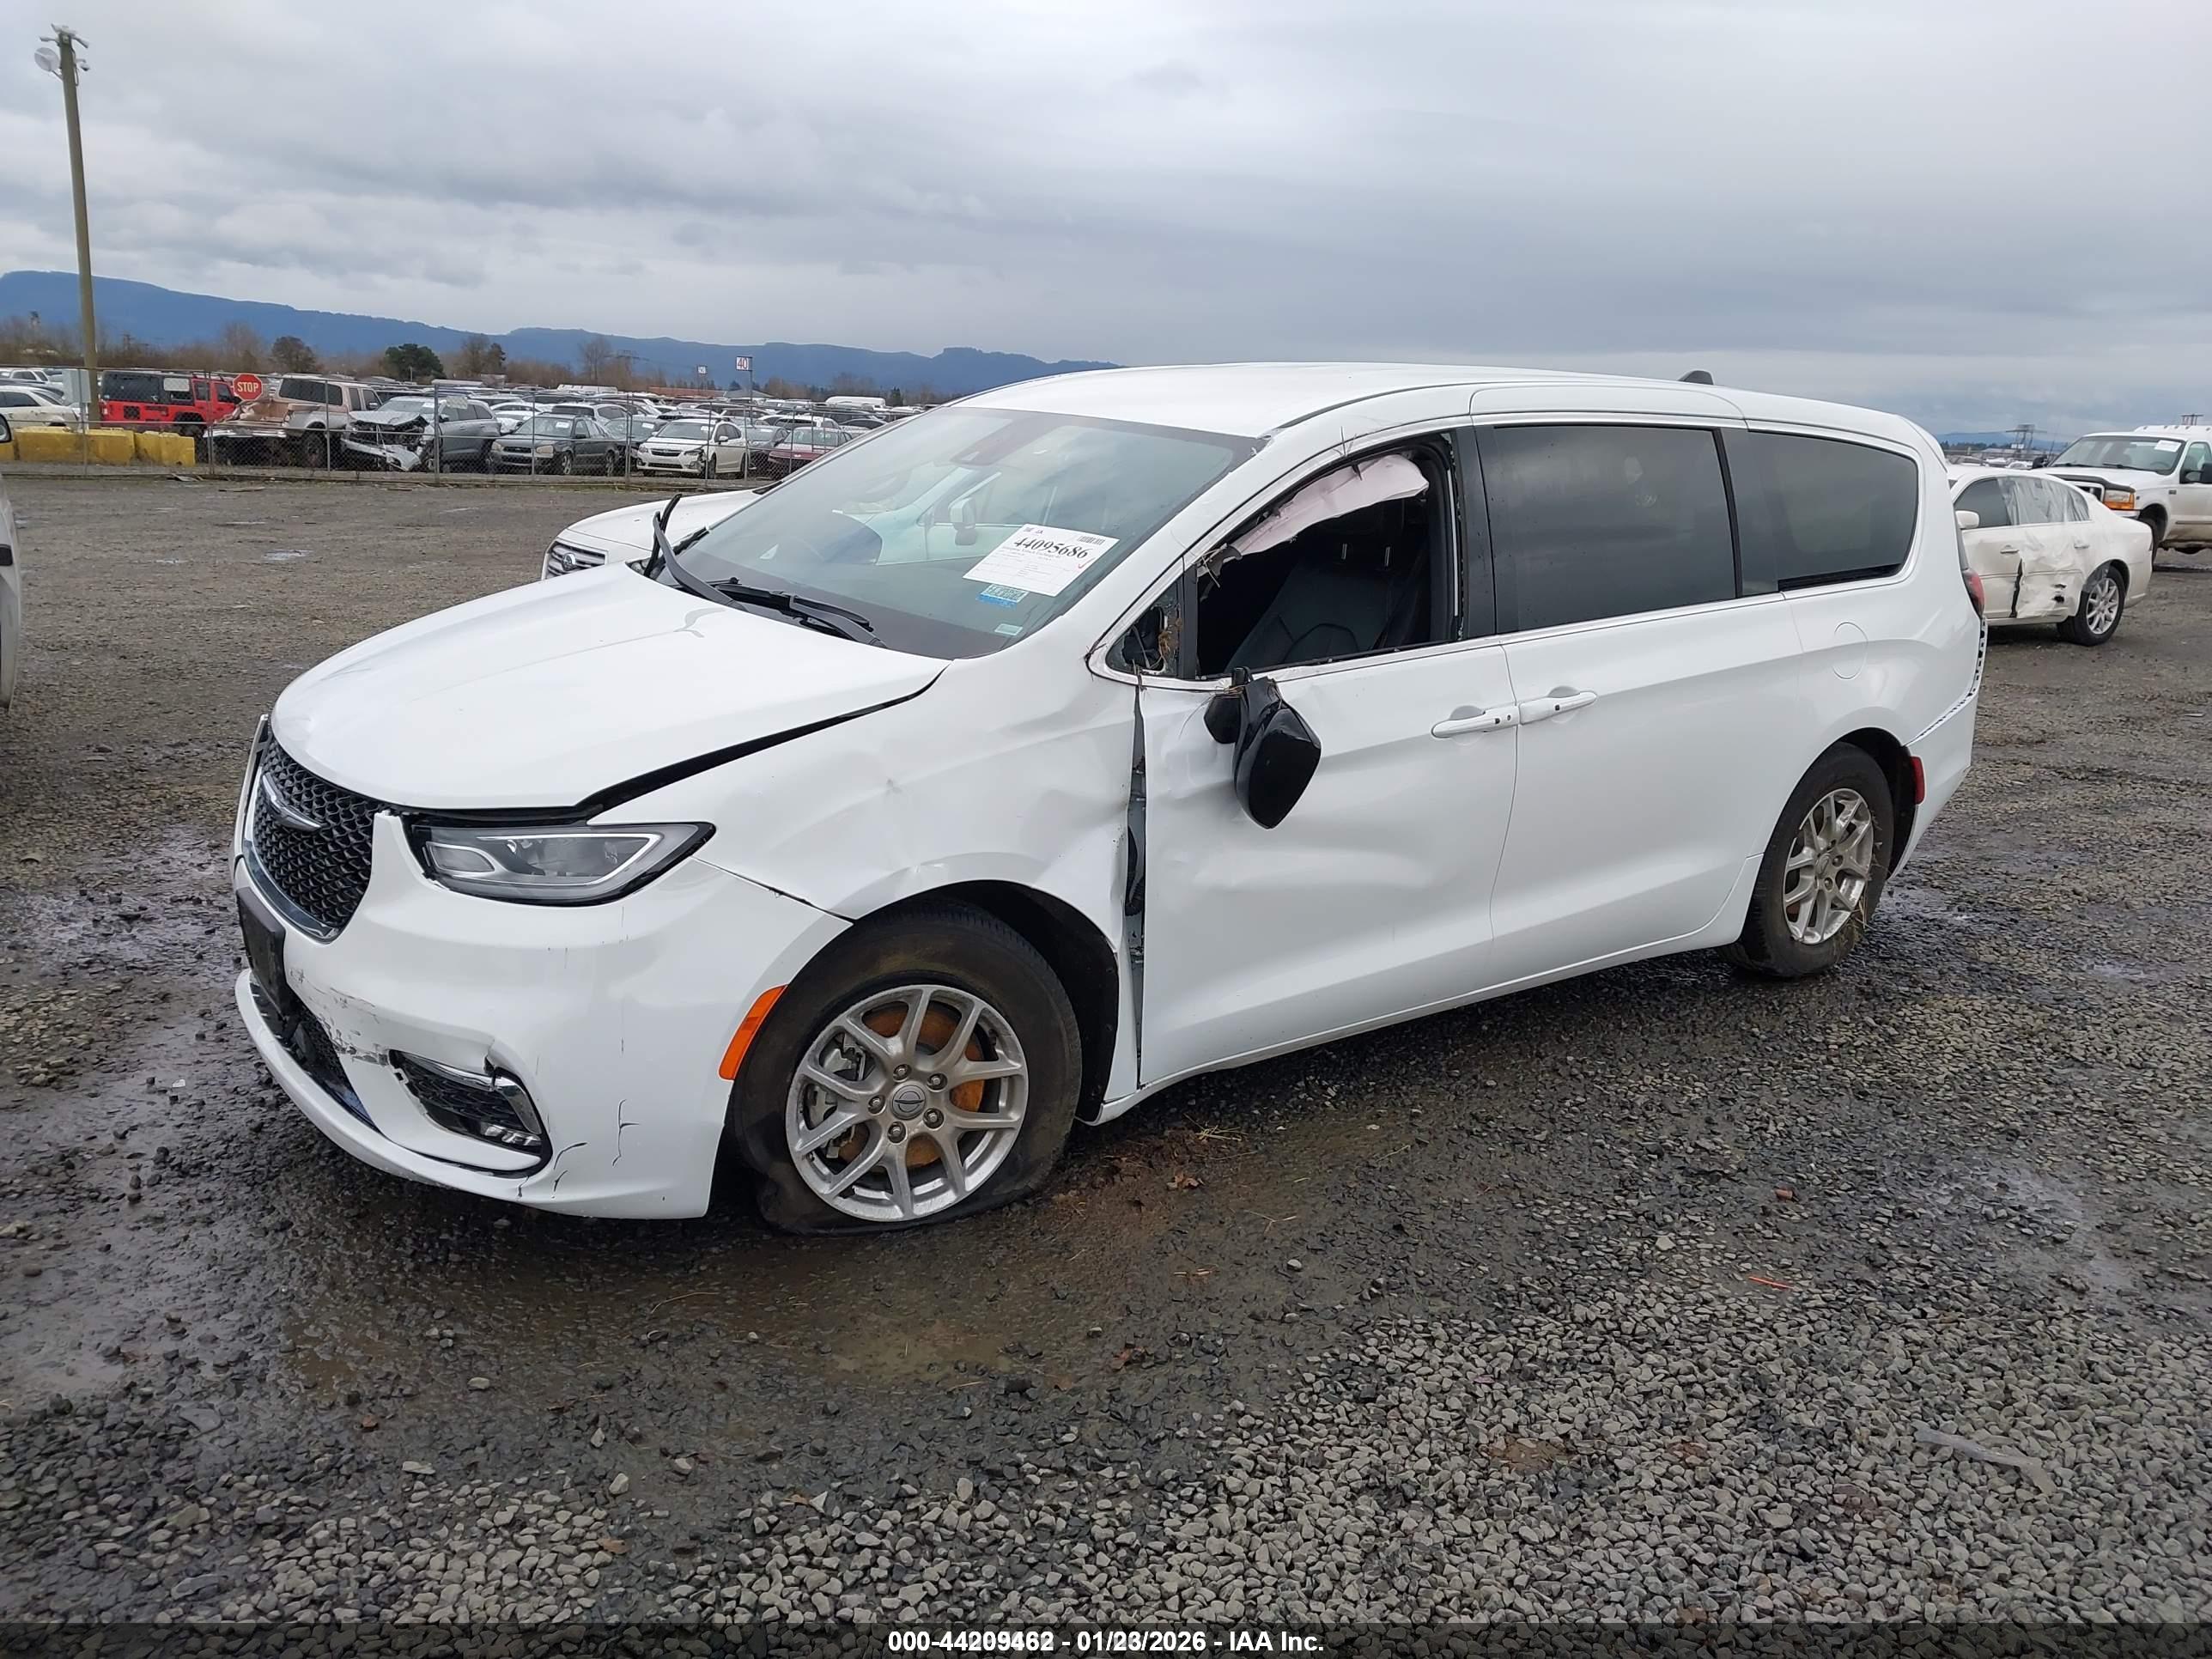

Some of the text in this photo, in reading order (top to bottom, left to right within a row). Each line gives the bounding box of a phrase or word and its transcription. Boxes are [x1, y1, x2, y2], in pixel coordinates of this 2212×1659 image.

[737, 357, 748, 369] 40
[237, 381, 259, 392] STOP
[1013, 537, 1093, 559] 44095686
